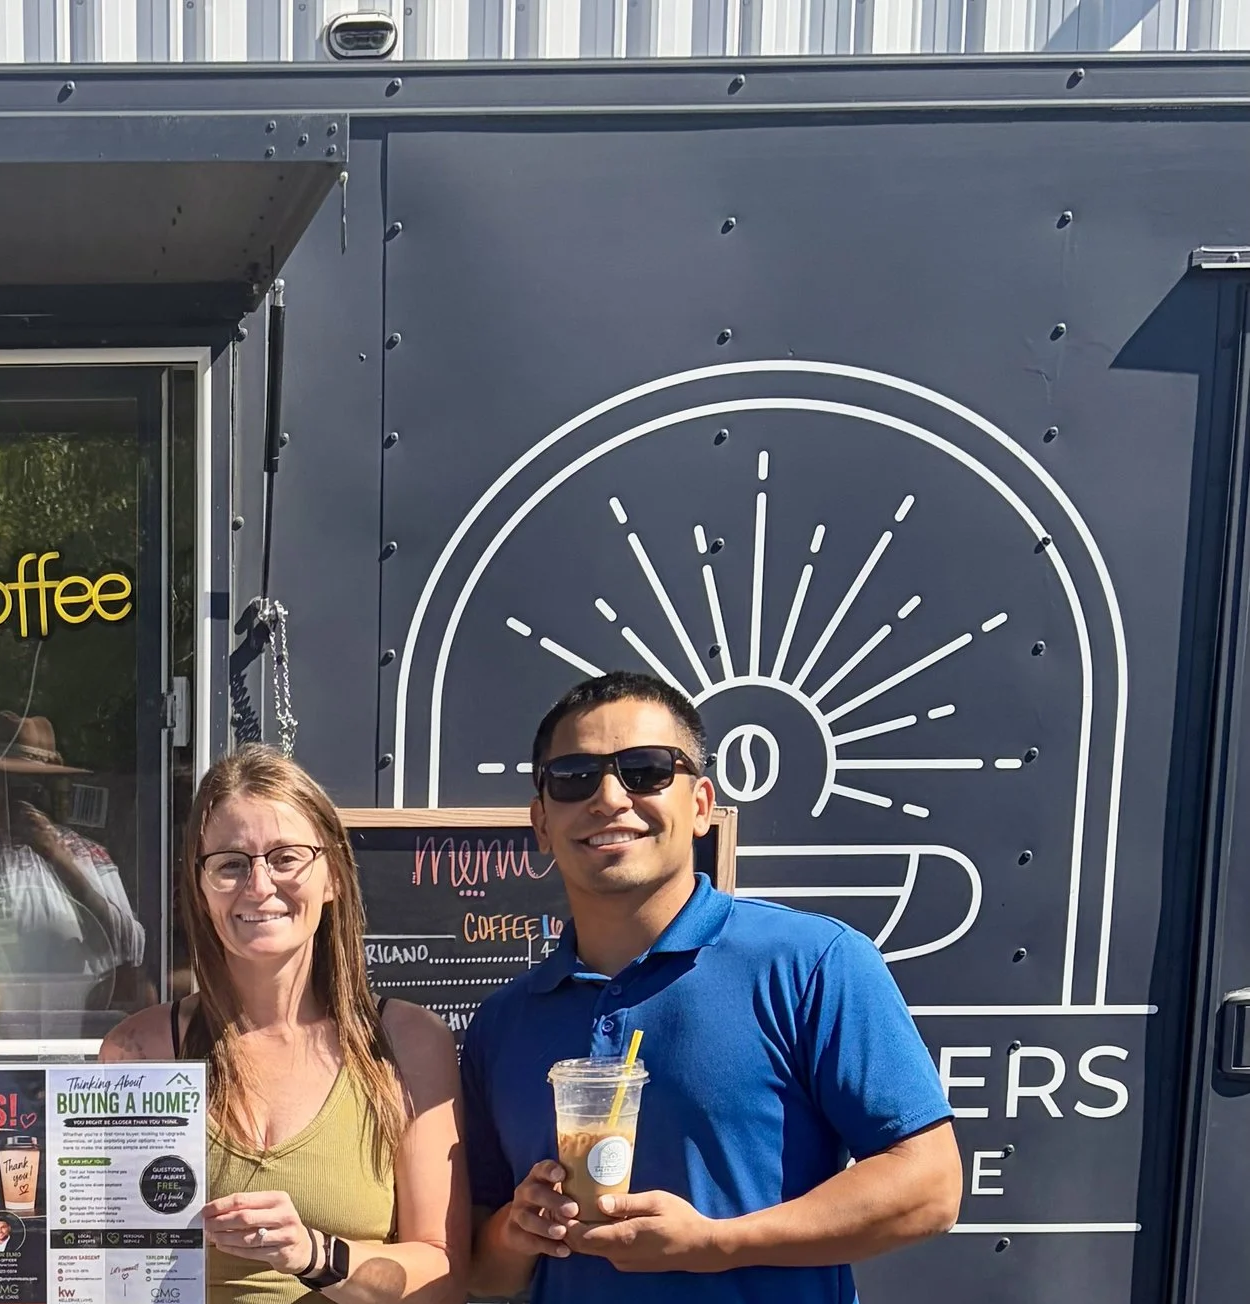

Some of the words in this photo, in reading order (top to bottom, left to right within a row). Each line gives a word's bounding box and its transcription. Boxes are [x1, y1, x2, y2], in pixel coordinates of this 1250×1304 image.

[464, 912, 540, 943] COFFEE
[365, 944, 429, 965] RICANO
[66, 1076, 112, 1092] Thinking
[114, 1075, 146, 1090] About
[938, 1045, 1130, 1119] ERS
[57, 1092, 119, 1114] BUYING
[125, 1092, 136, 1114] A
[142, 1091, 200, 1113] HOME?
[3, 1157, 29, 1174] Thank
[58, 1286, 75, 1297] kw
[151, 1288, 181, 1298] CMG
